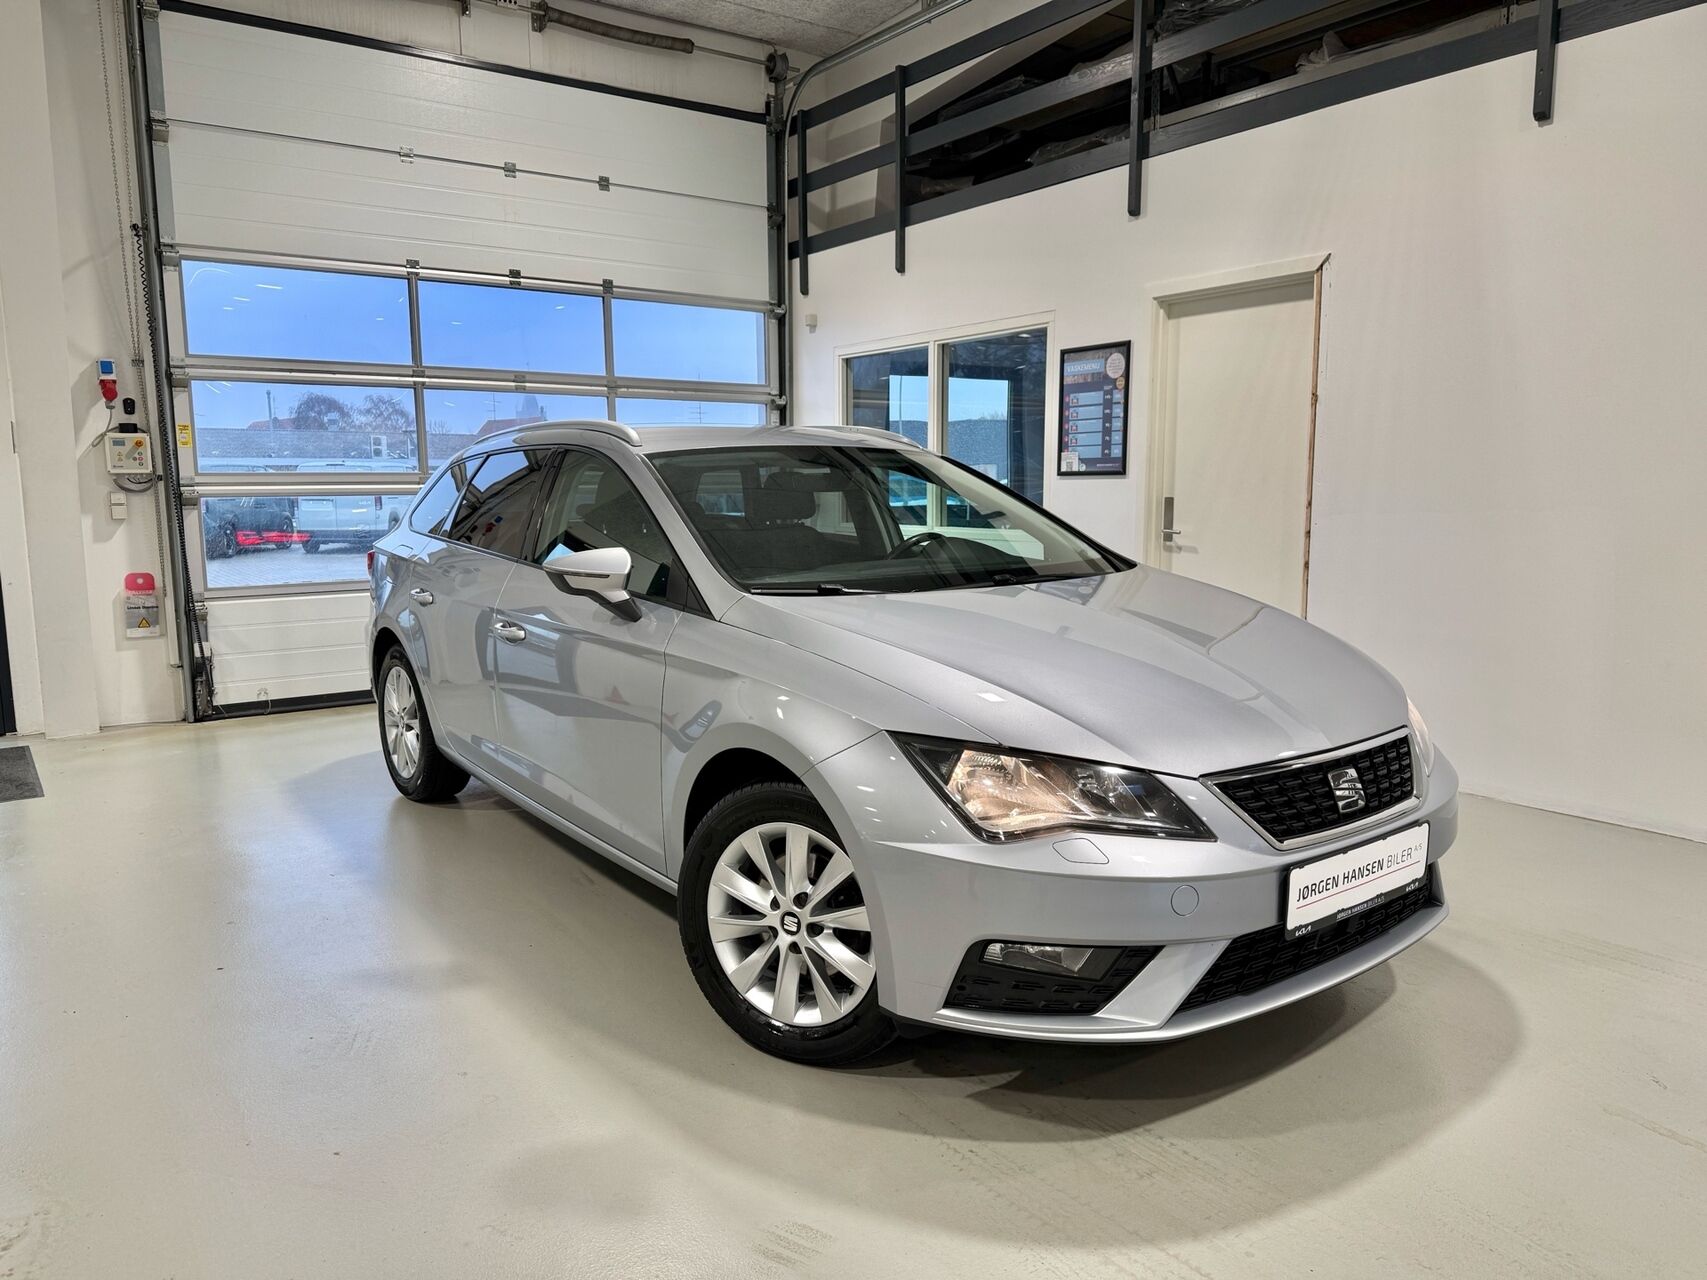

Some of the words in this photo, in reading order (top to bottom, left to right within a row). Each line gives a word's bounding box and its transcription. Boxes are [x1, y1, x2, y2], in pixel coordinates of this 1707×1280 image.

[1296, 874, 1339, 903] JØRGEN
[1342, 858, 1384, 885] HANSEN
[1386, 847, 1412, 869] BILER
[1413, 843, 1423, 852] A/S
